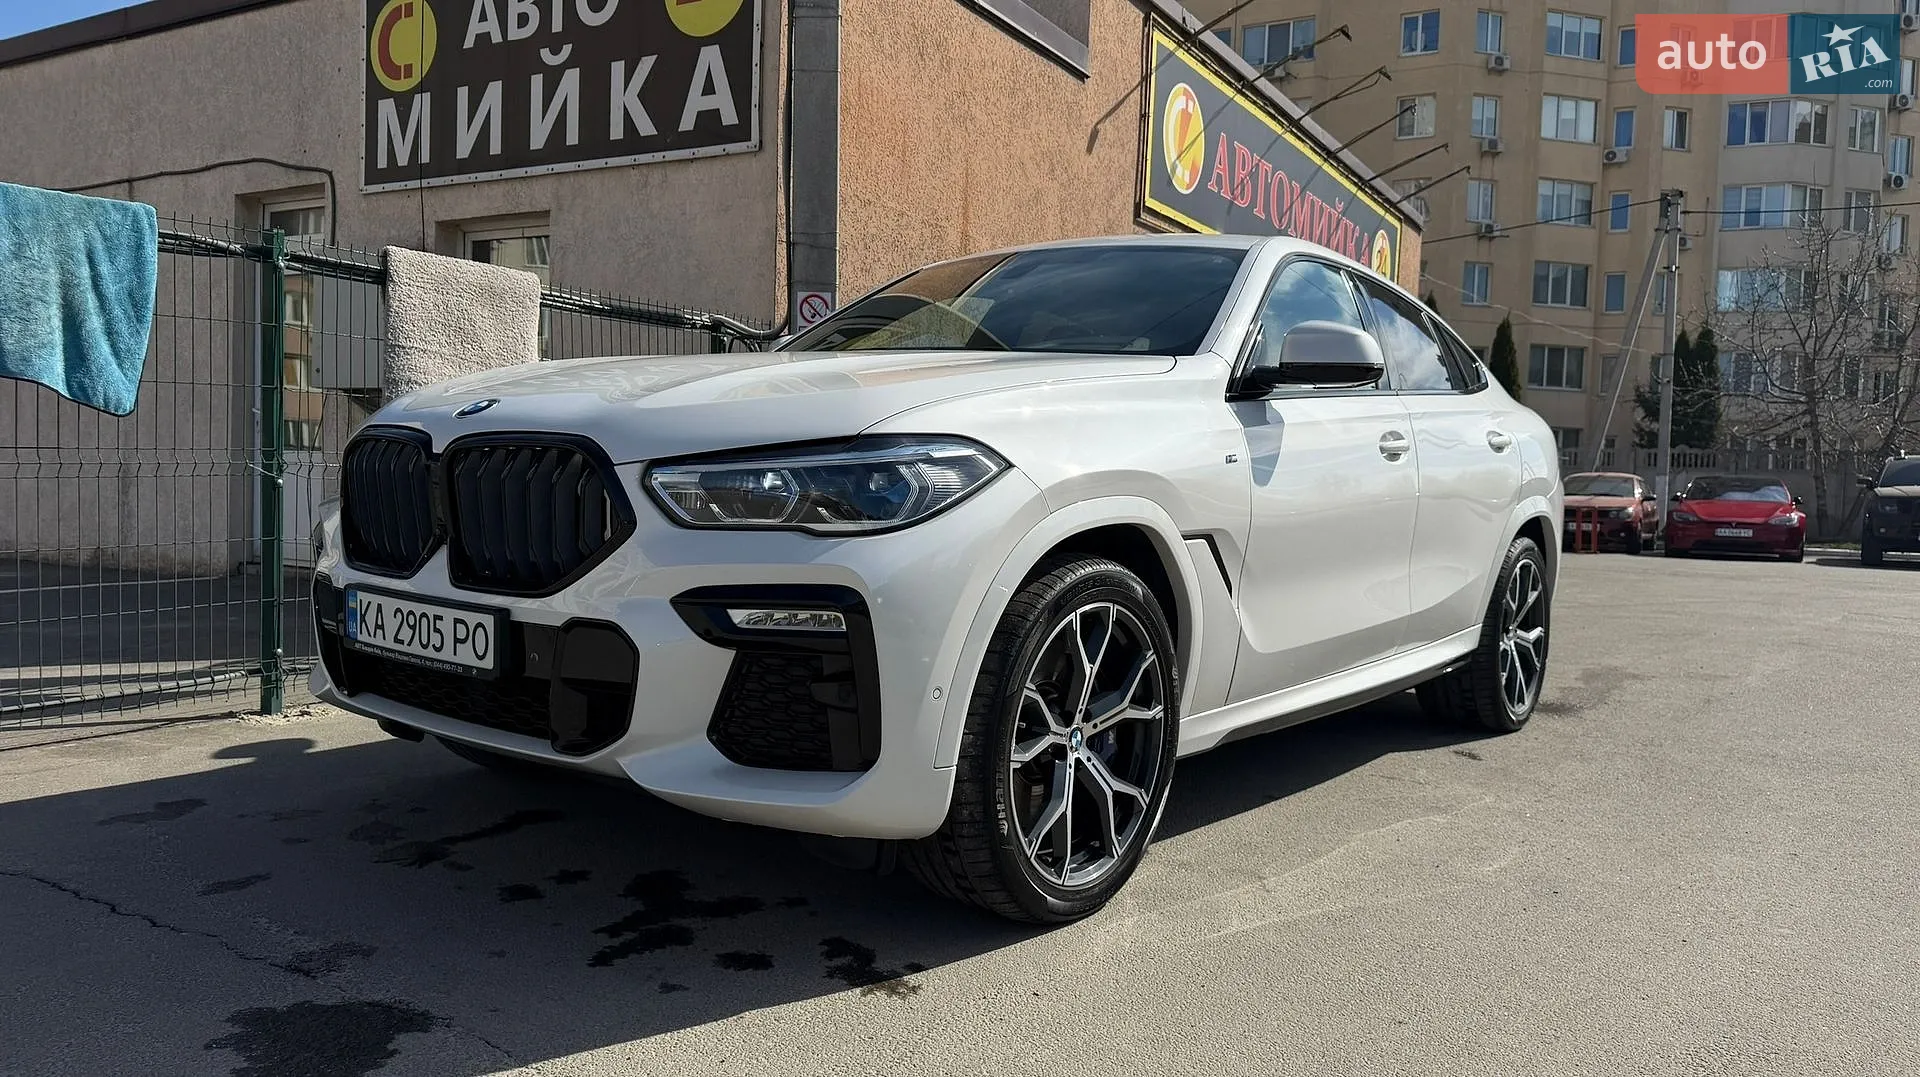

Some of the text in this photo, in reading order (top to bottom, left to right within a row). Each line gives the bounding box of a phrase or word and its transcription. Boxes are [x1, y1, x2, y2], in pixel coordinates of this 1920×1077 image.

[462, 0, 620, 49] АВТО
[376, 44, 740, 169] МИЙКА
[1207, 131, 1370, 267] АВТОМИЙКА
[359, 598, 386, 640] KA
[393, 606, 444, 653] 2905
[453, 617, 489, 661] PO
